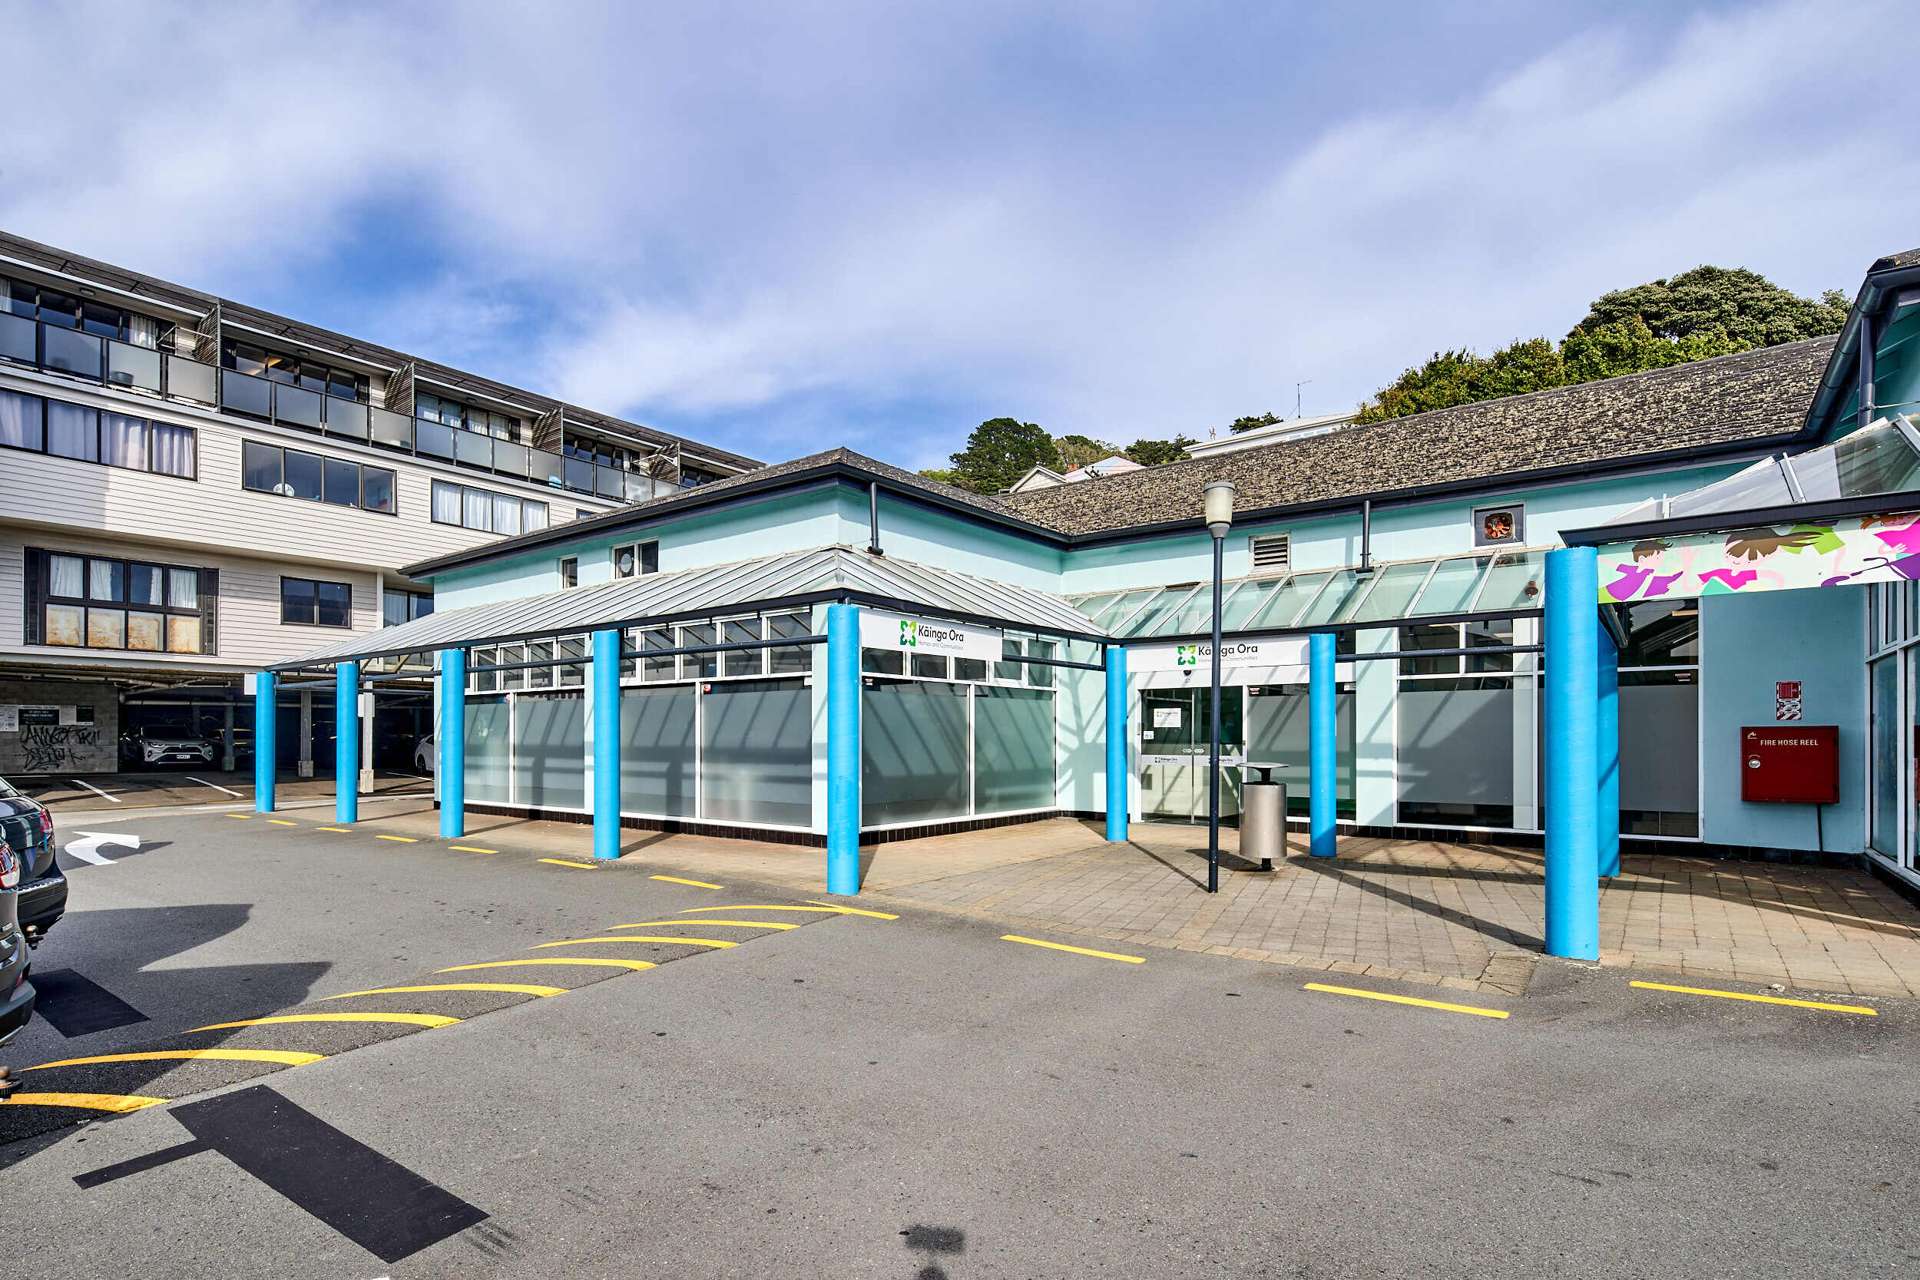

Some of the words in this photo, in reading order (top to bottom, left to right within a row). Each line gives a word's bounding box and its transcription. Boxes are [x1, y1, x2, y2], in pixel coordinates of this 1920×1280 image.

[918, 625, 948, 642] Kāinga
[949, 629, 964, 642] Ora
[1198, 645, 1235, 657] Kāga
[1237, 643, 1258, 654] Ora
